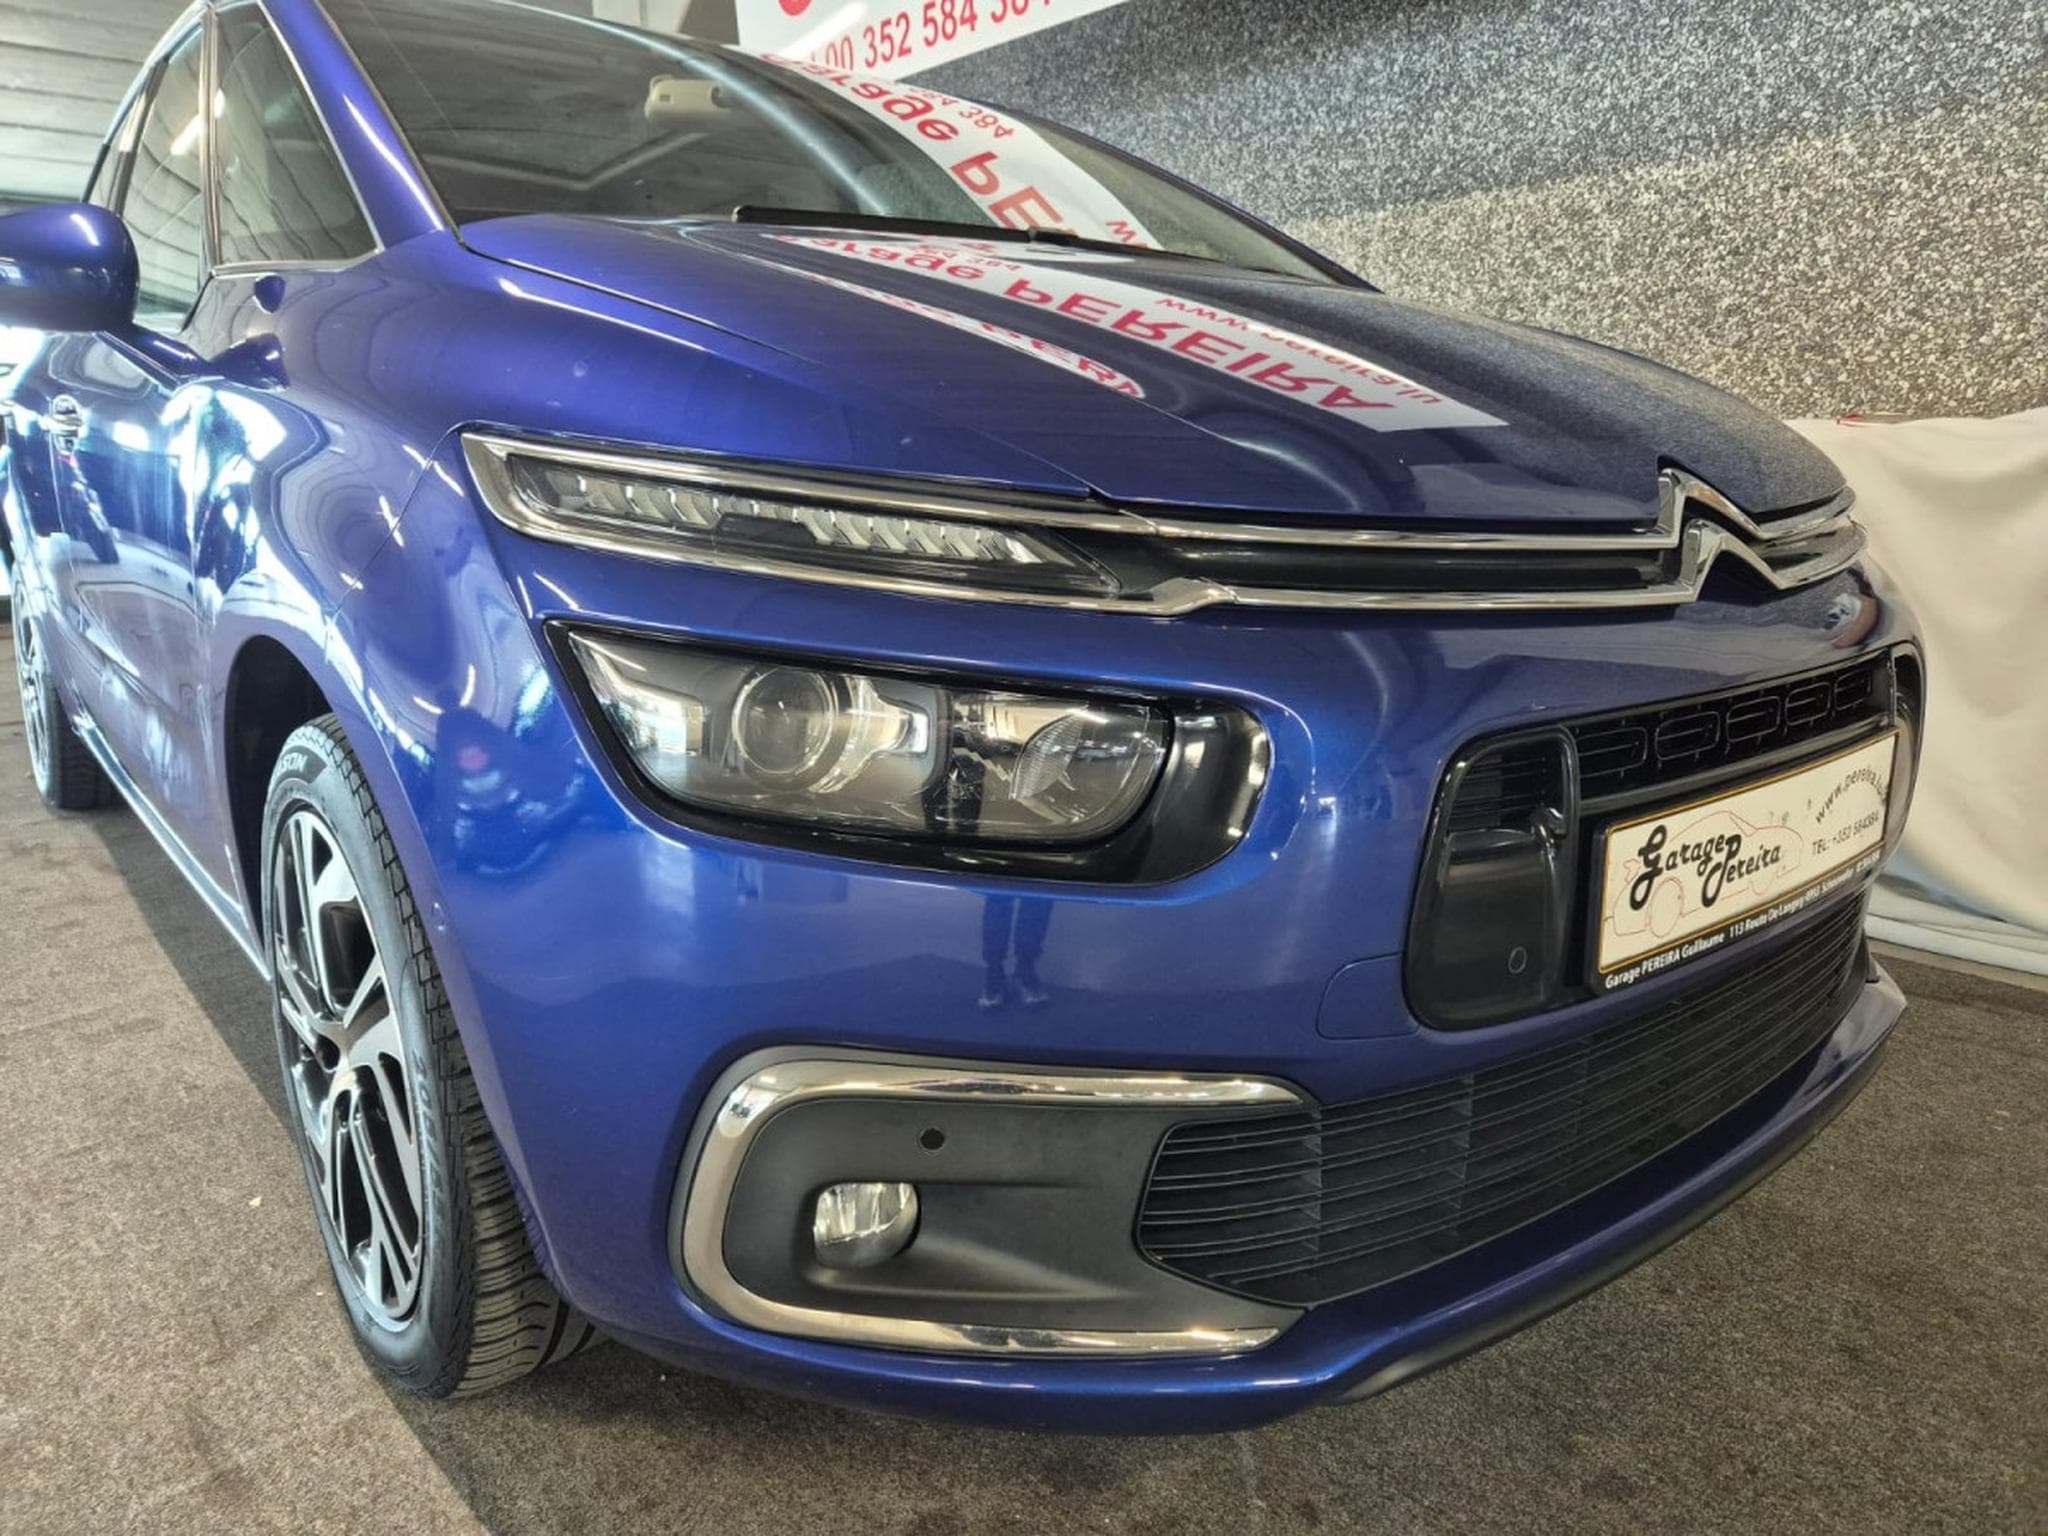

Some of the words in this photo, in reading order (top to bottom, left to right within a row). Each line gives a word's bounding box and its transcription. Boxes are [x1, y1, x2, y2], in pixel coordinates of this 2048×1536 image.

[863, 12, 912, 68] 352
[922, 0, 978, 48] 584
[1629, 824, 1725, 911] Garage
[1701, 833, 1781, 908] Pereira
[1605, 966, 1640, 989] Garage
[1641, 947, 1680, 975] PEREIRA
